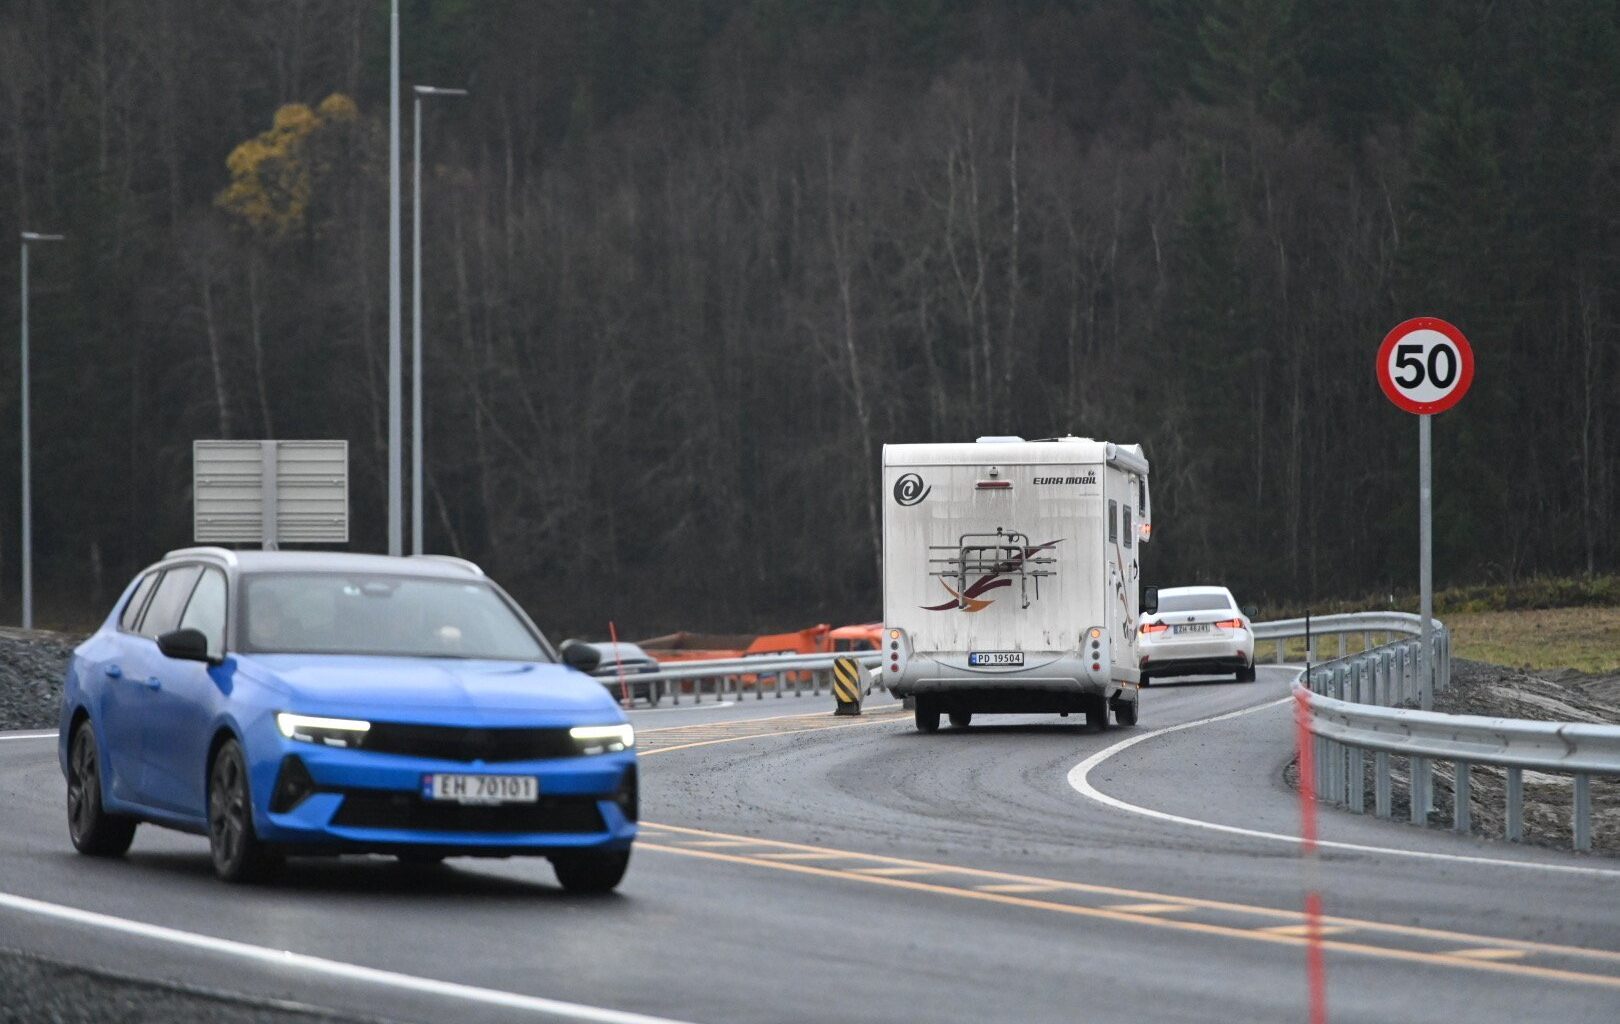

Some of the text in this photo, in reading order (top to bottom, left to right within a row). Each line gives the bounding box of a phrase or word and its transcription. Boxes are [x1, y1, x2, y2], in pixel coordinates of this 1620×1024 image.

[1394, 343, 1457, 389] 50
[1033, 476, 1097, 485] EURA MOBIL
[978, 654, 1020, 663] PD 19504
[441, 775, 532, 796] EH 70101
